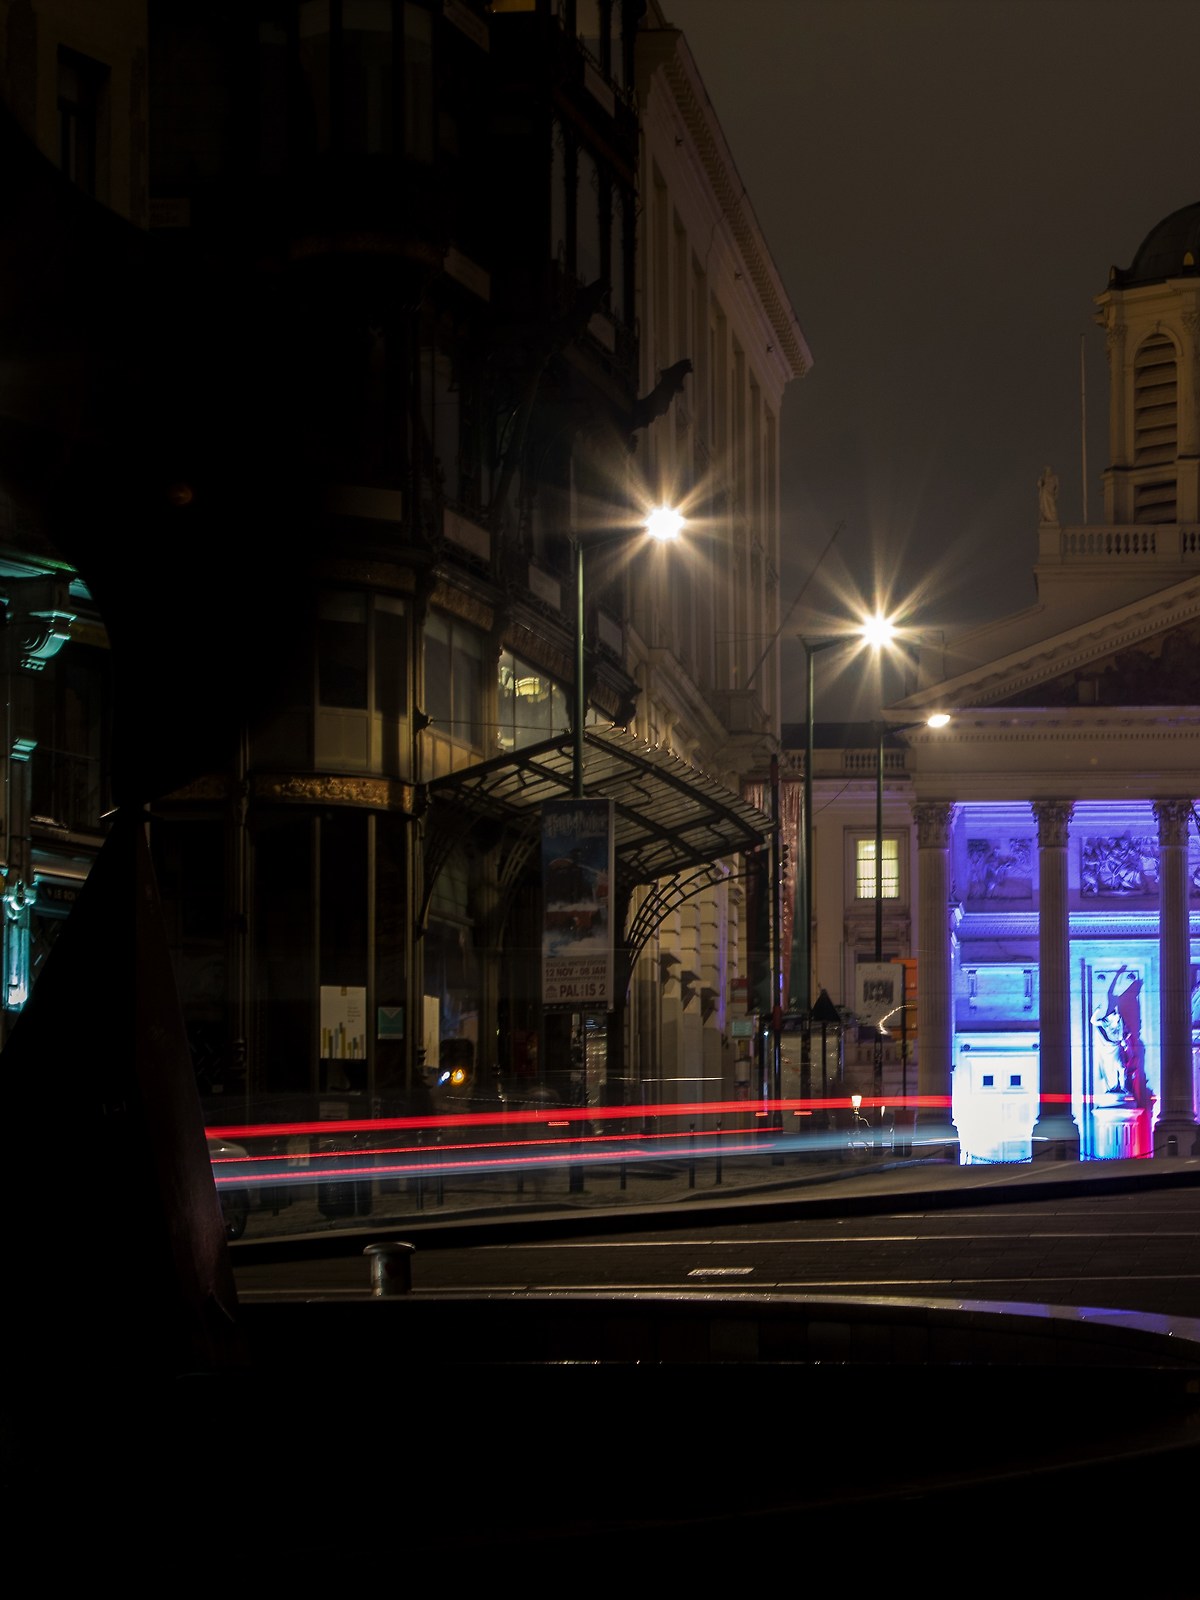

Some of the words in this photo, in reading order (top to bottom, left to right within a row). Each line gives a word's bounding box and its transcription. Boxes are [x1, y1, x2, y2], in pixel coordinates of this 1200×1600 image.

[545, 967, 555, 977] 12
[556, 967, 574, 976] NOV
[592, 966, 607, 975] JAN
[598, 983, 606, 996] 2
